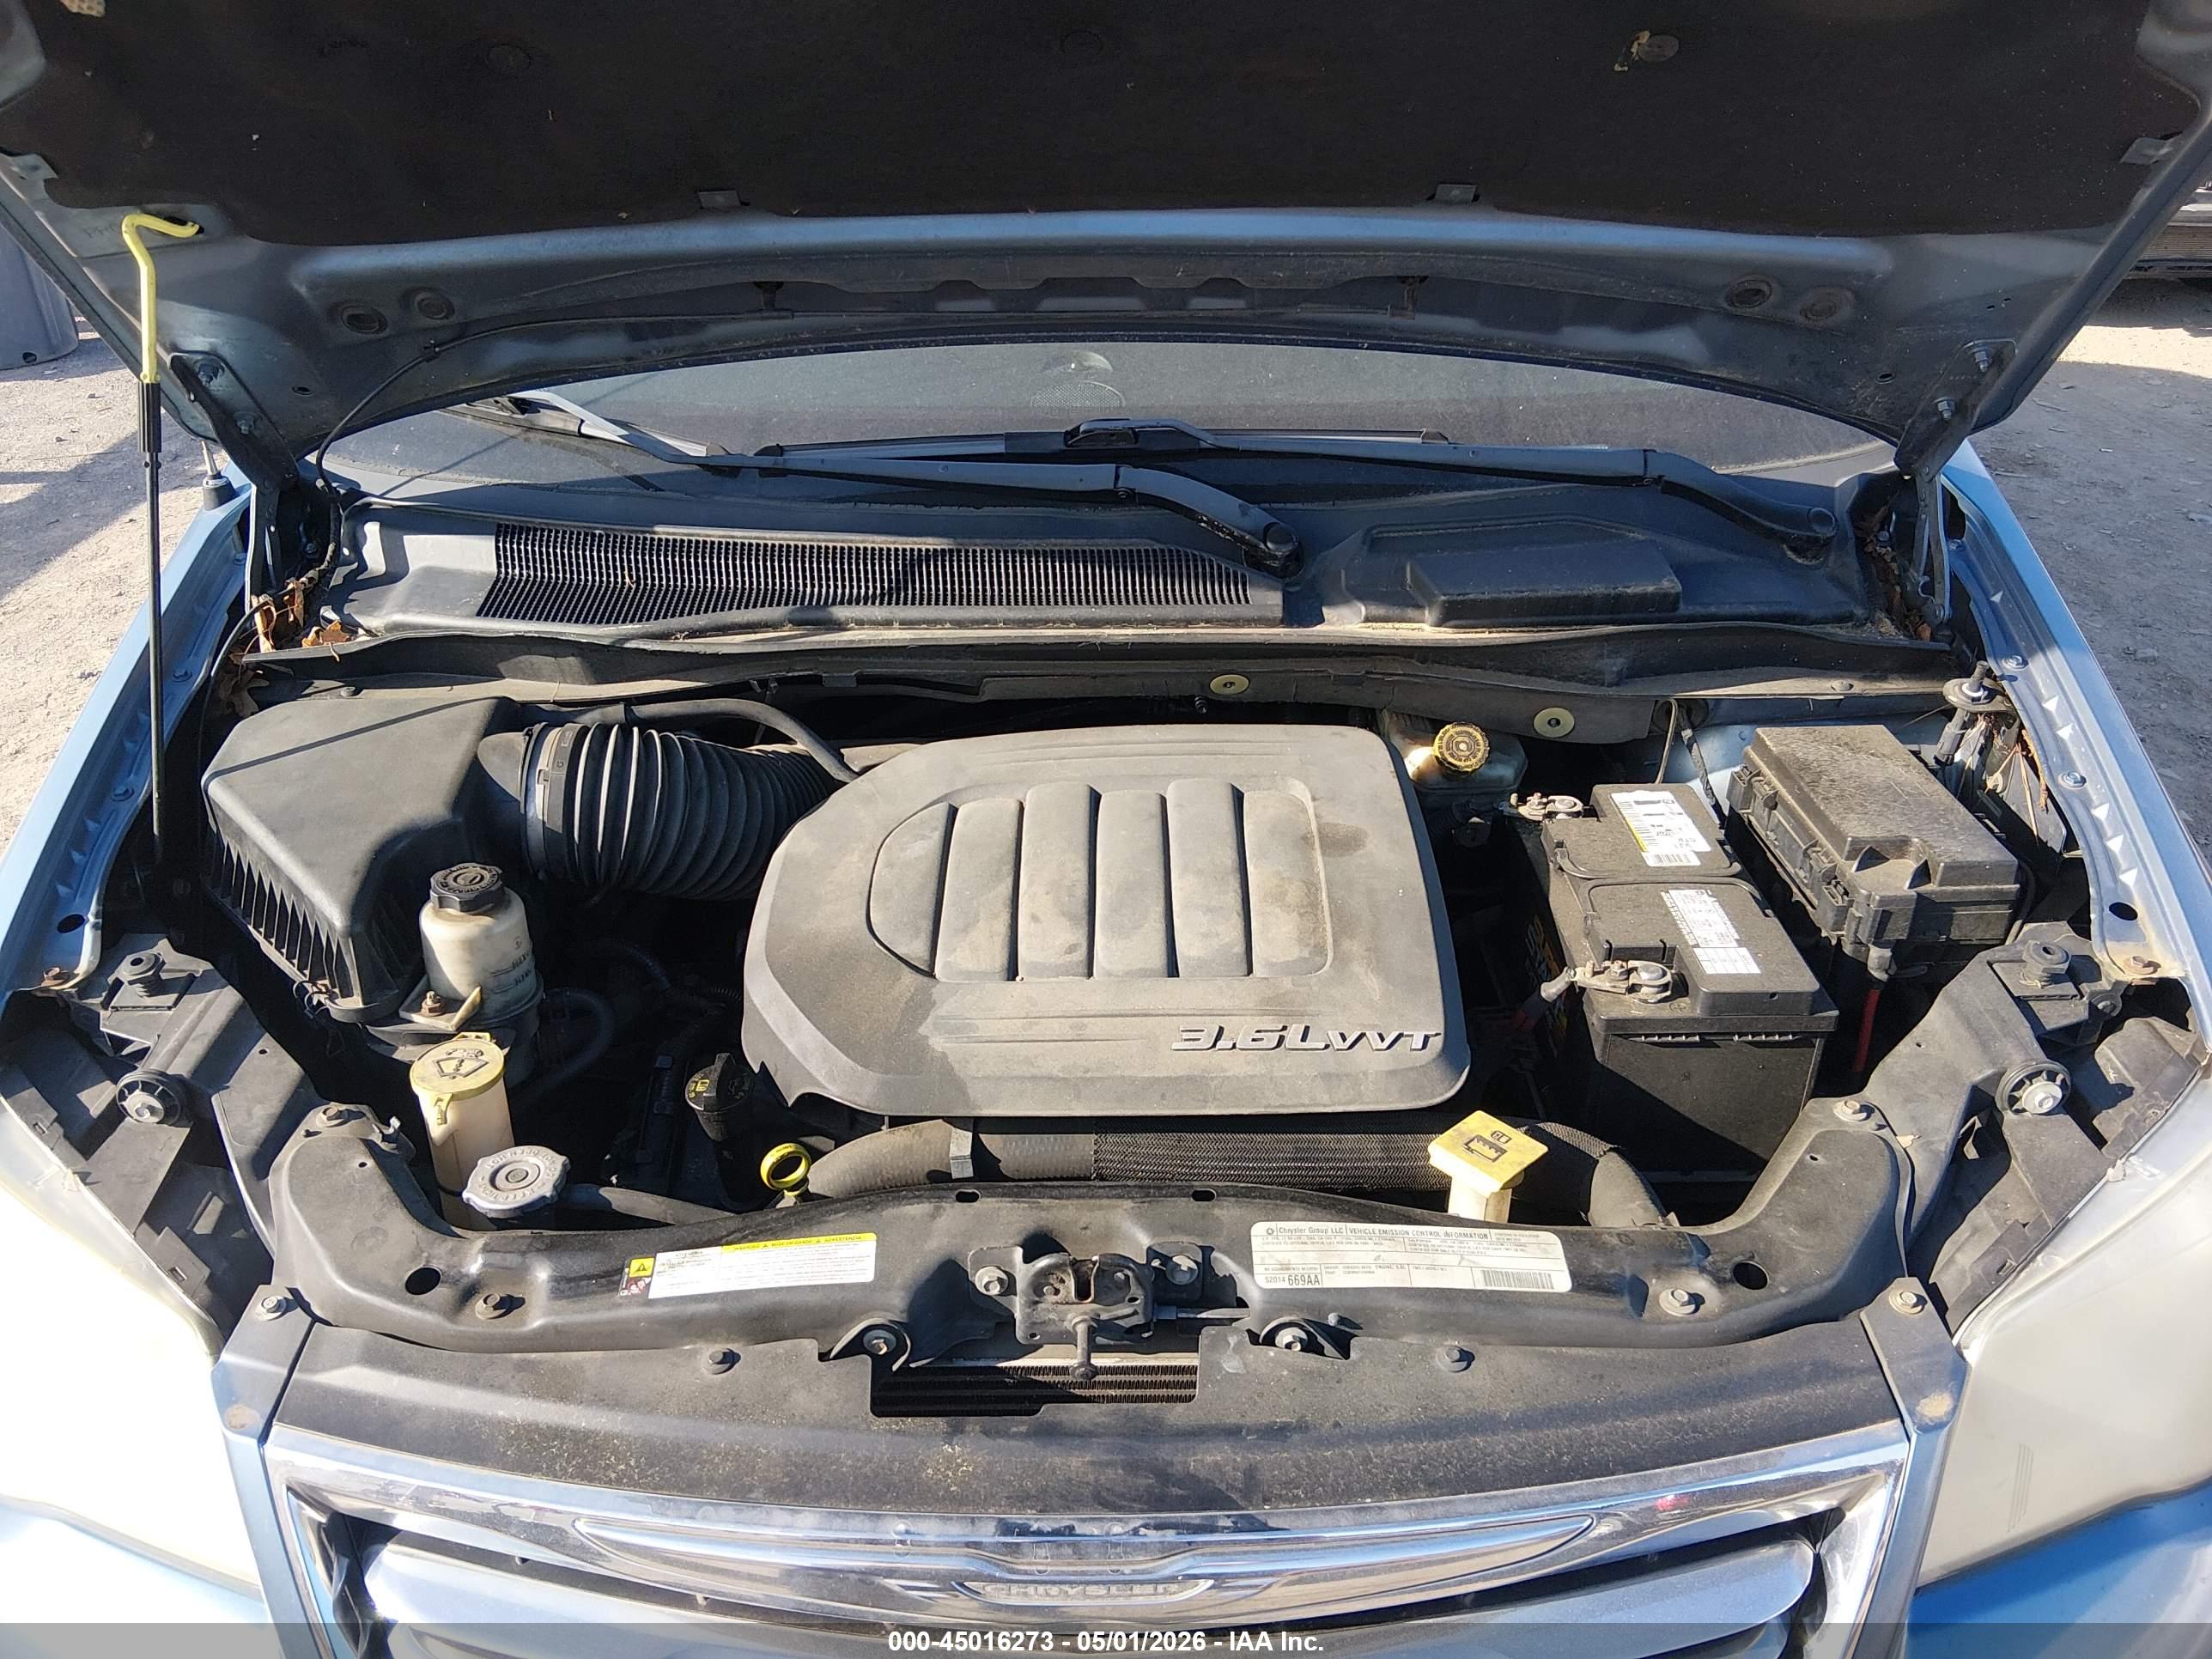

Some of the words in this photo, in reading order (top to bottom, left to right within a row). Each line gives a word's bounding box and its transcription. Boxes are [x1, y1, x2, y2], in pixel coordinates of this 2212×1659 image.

[1279, 1226, 1307, 1237] Chrysler
[1308, 1226, 1329, 1236] Group
[1349, 1227, 1376, 1236] VEHICLE
[1377, 1228, 1410, 1237] EMISSION
[1411, 1229, 1442, 1237] CONTROL
[1443, 1231, 1489, 1240] INFORMATION
[1287, 1275, 1320, 1285] 669AA
[981, 1583, 1180, 1595] CHRYSLER
